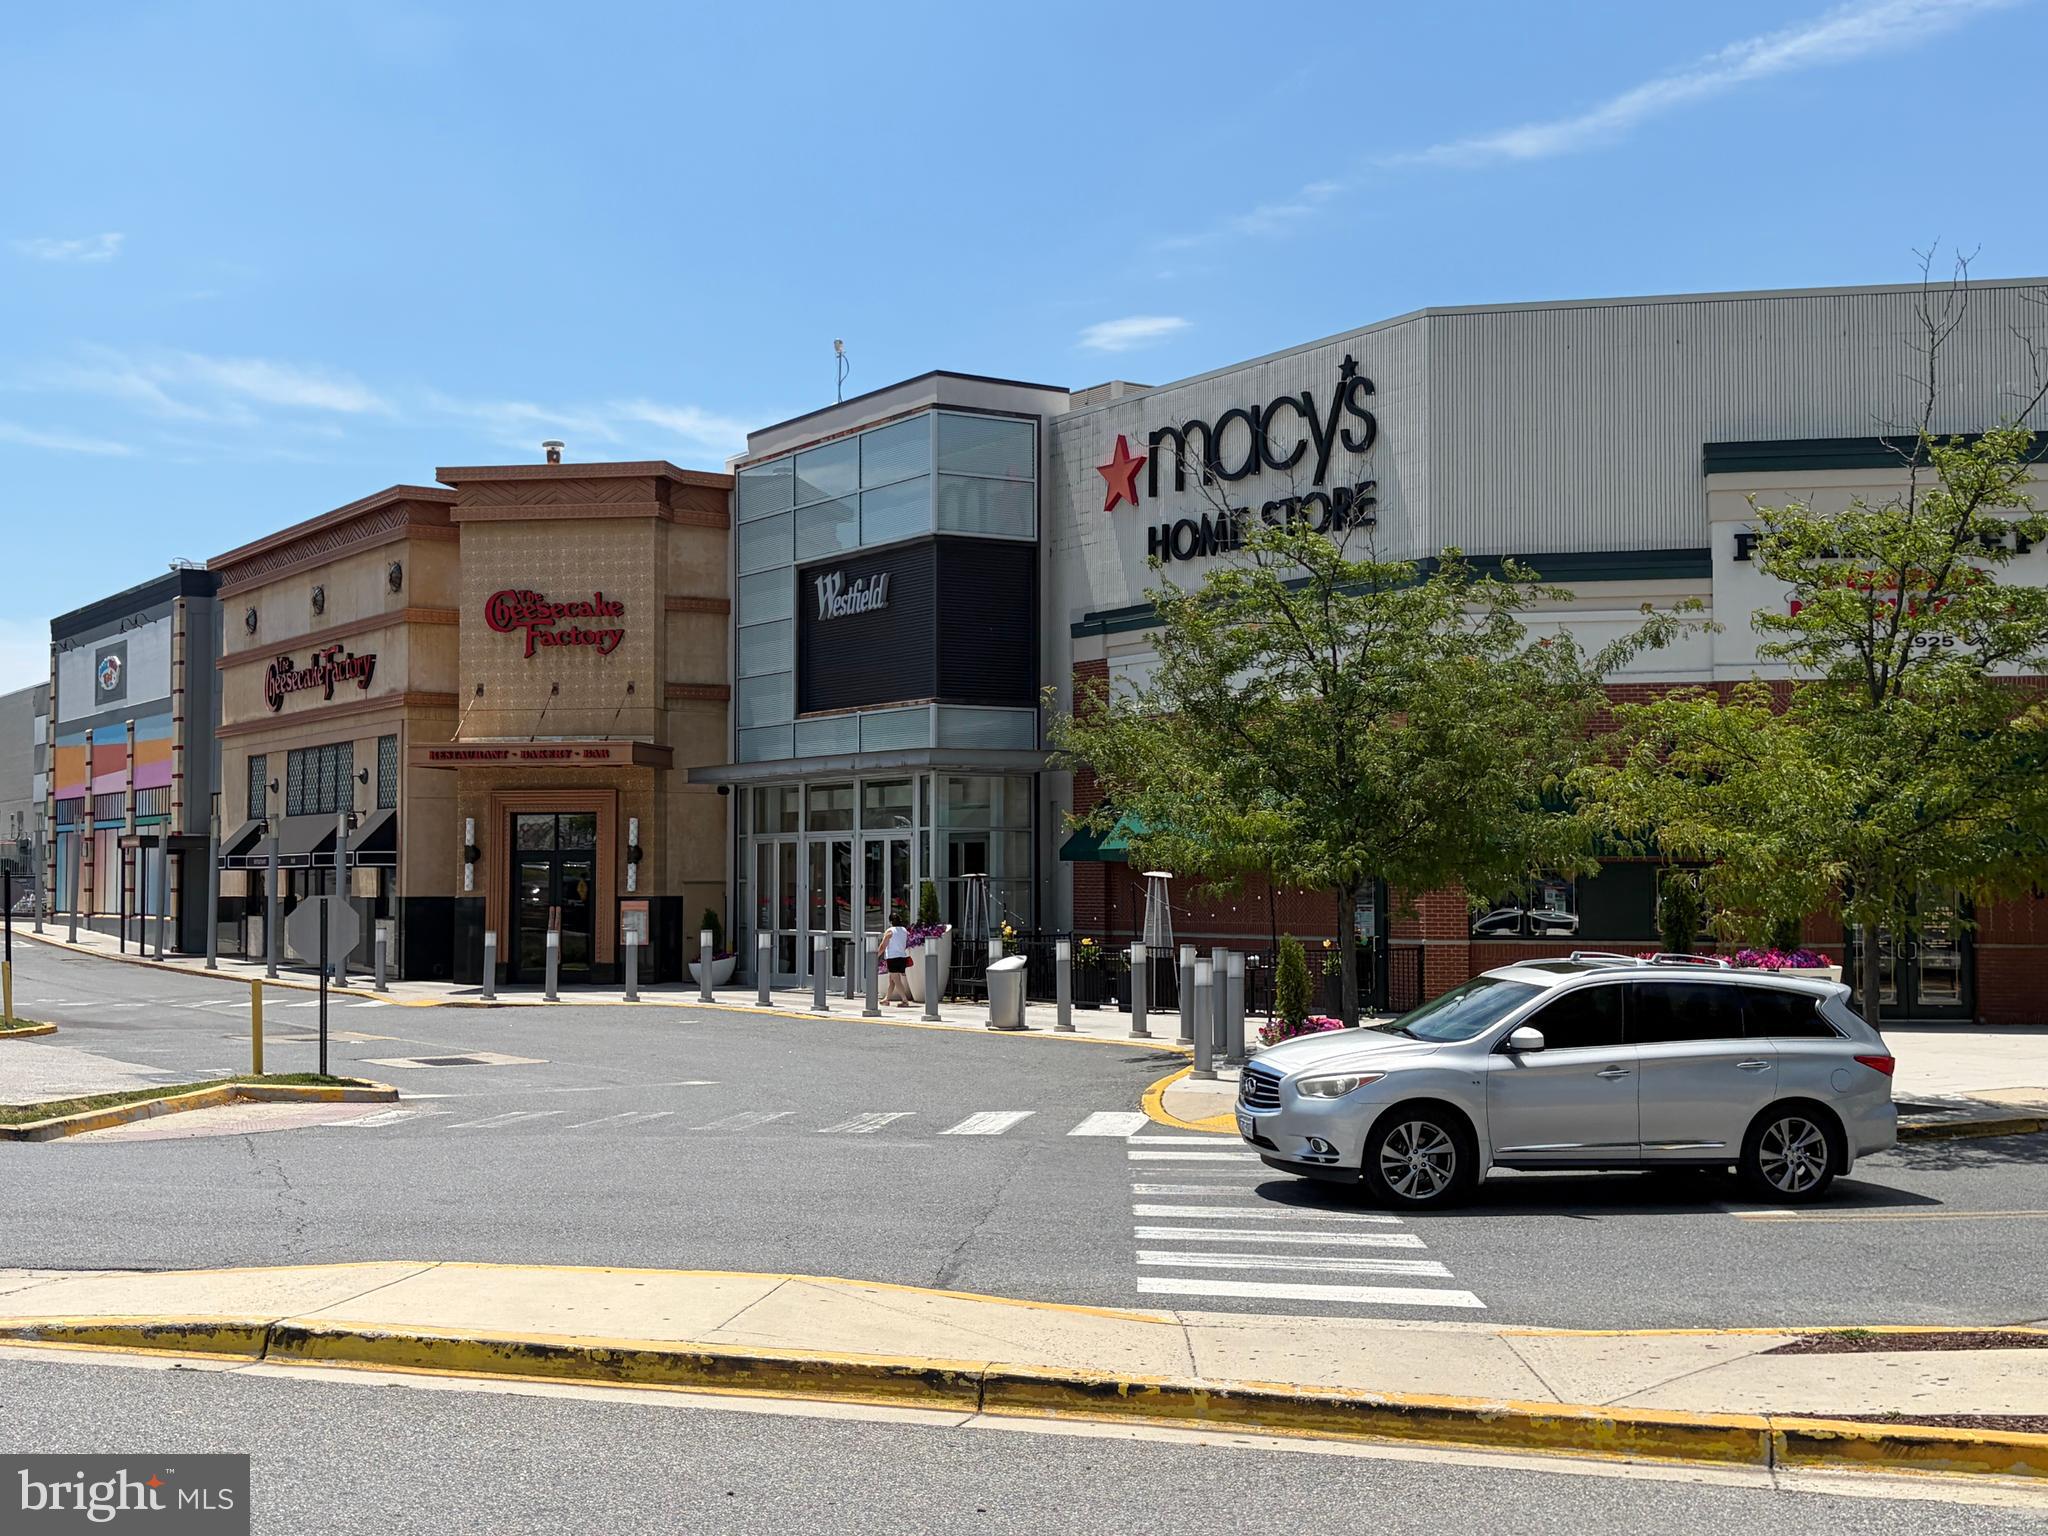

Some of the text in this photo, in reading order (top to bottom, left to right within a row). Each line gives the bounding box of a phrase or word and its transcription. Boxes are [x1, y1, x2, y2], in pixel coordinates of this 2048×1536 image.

[1149, 354, 1377, 498] macy's
[1148, 507, 1250, 563] HOME
[485, 589, 625, 634] Cheesecake
[519, 590, 545, 603] The
[814, 571, 890, 622] Westfield
[513, 617, 625, 658] Factory
[265, 644, 376, 712] Cheesecake Factory
